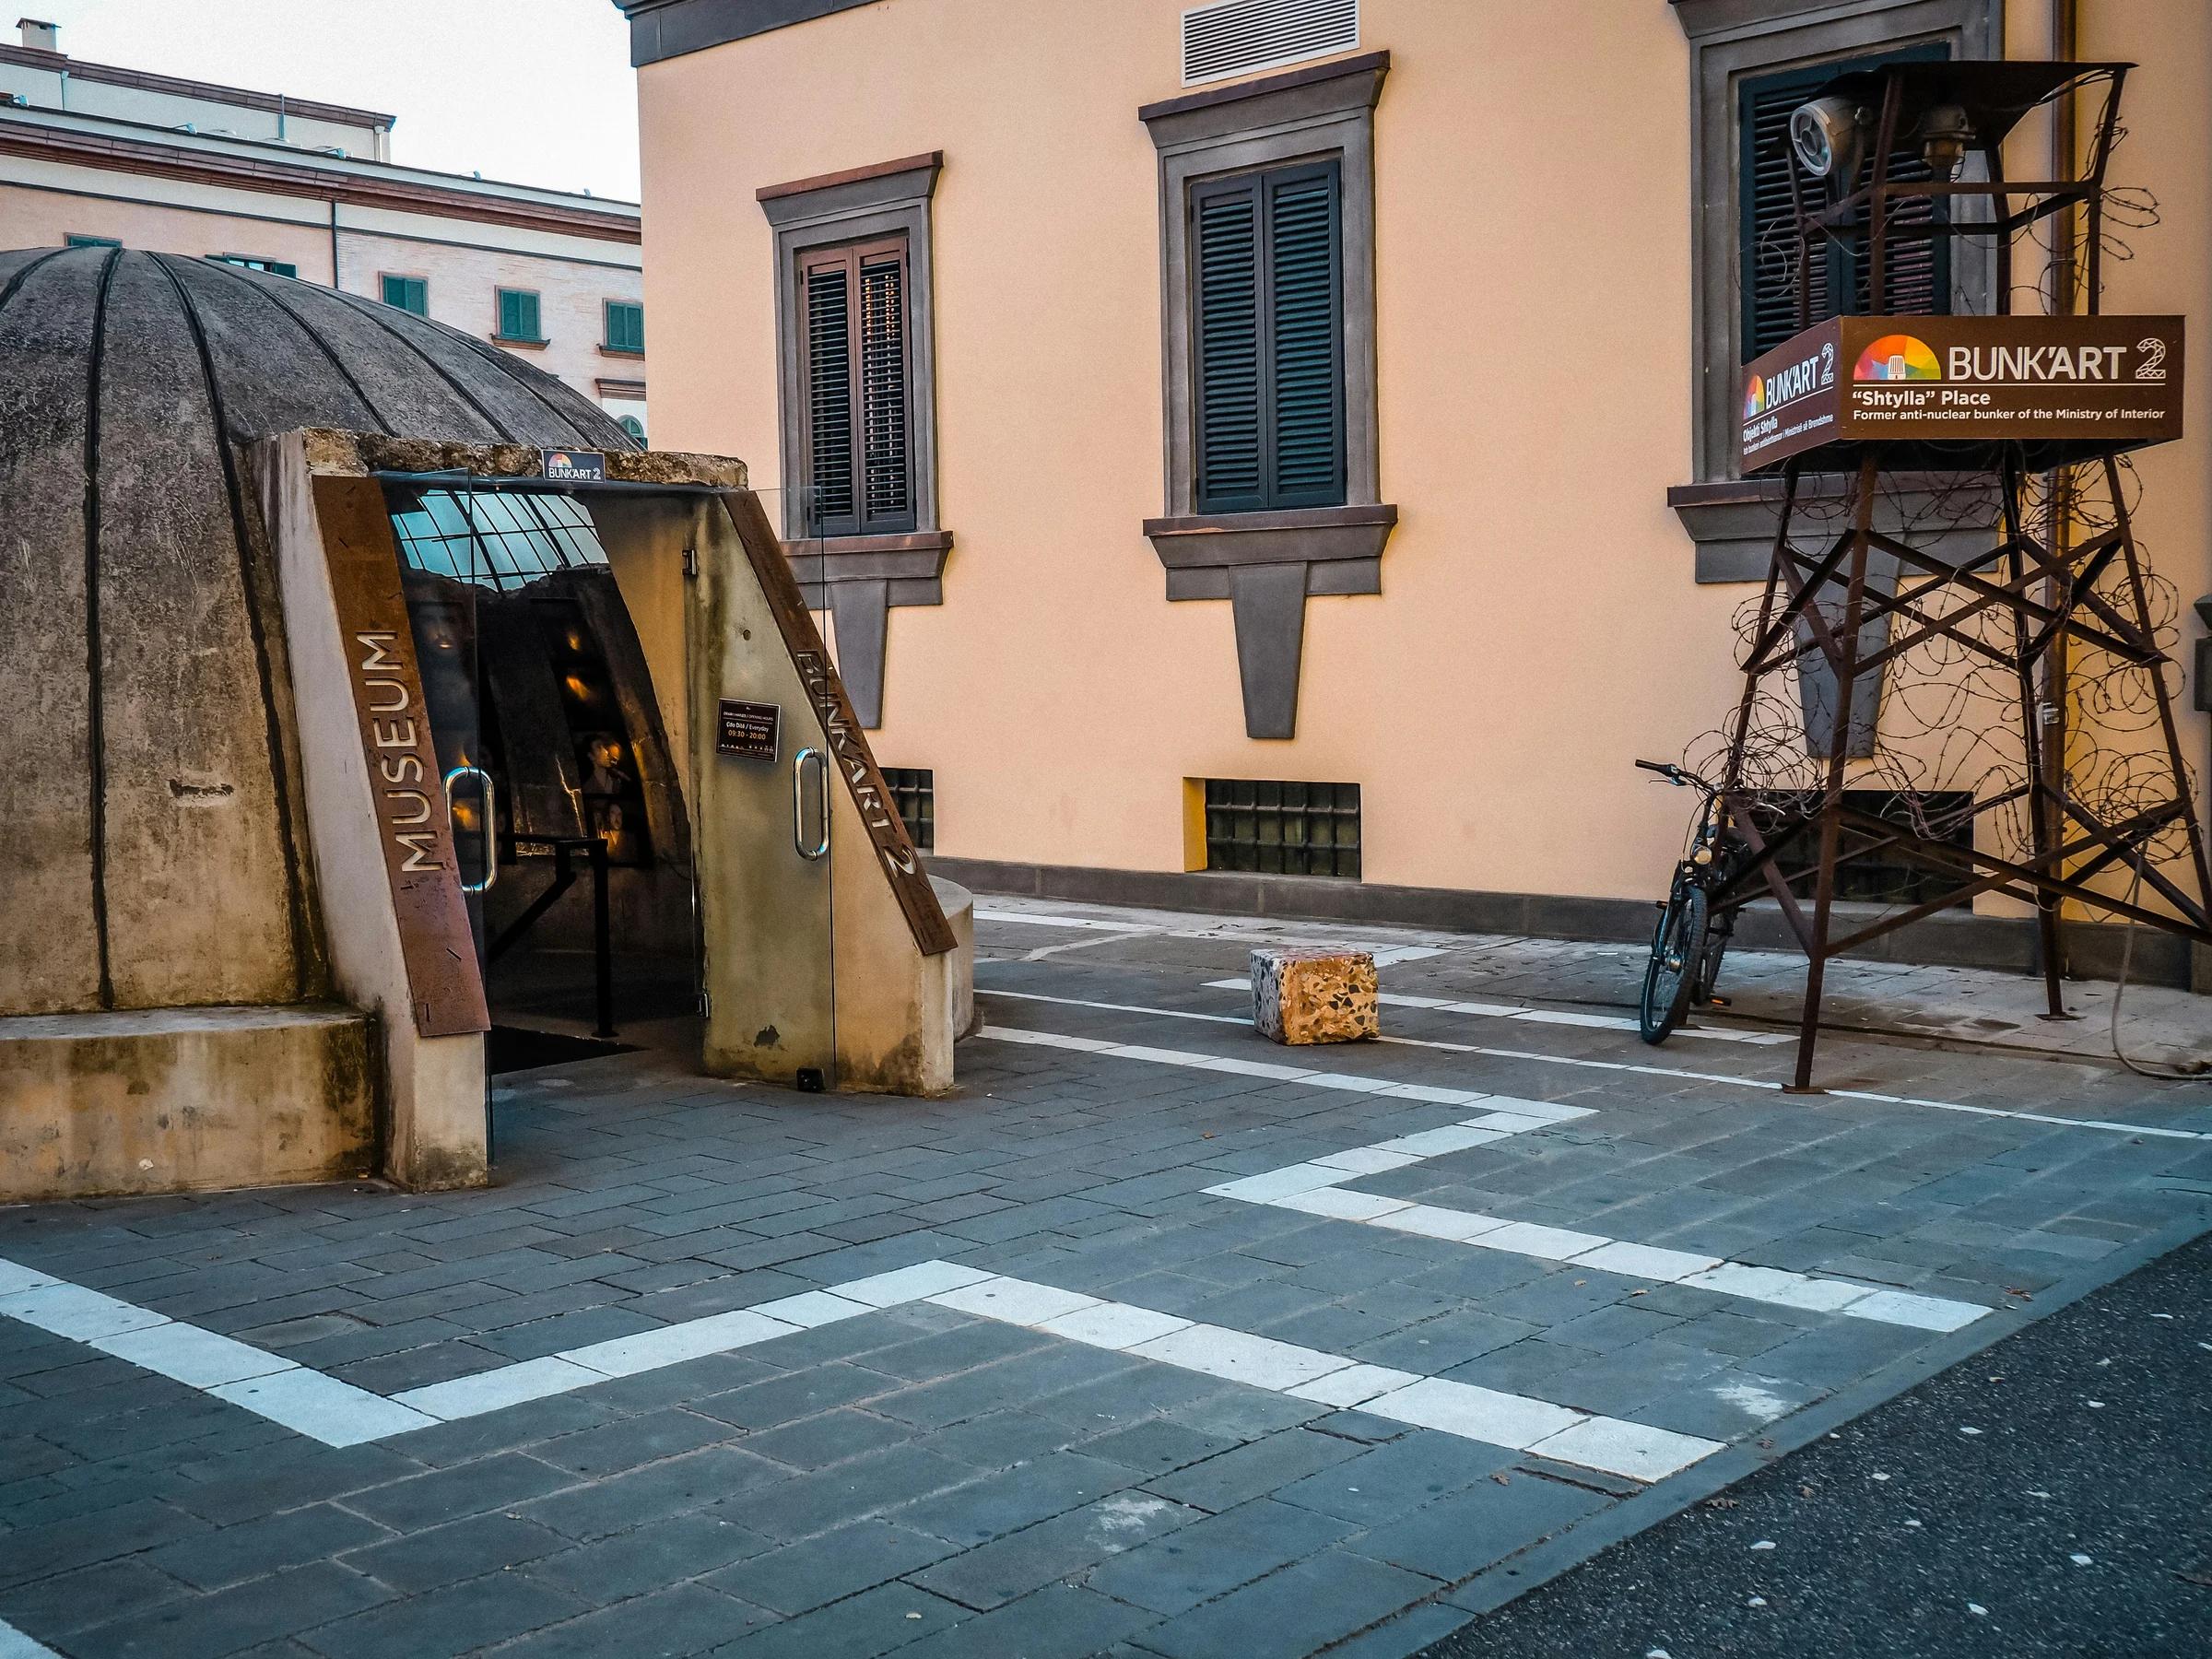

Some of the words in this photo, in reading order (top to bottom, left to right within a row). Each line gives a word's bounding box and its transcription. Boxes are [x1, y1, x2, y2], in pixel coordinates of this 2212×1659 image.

[1948, 346, 2127, 381] BUNK'ART
[2136, 337, 2167, 380] 2
[1766, 356, 1819, 409] BUNK'ART
[1821, 342, 1834, 385] 2
[1941, 390, 1991, 406] Place
[1853, 409, 1896, 420] Former
[1900, 408, 1971, 420] anti-nuclear
[1974, 408, 2016, 420] bunker
[2018, 408, 2031, 419] of
[2033, 408, 2053, 419] the
[2056, 408, 2102, 422] Ministry
[2105, 408, 2119, 419] of
[2121, 408, 2166, 419] Interior
[1743, 422, 1760, 442] Objekti
[1760, 416, 1778, 434] Shtylla
[548, 467, 591, 479] BUNK'ART
[593, 467, 601, 480] 2
[728, 729, 745, 737] 09:30
[749, 732, 766, 740] 20:00
[748, 724, 769, 733] Everyday
[356, 630, 444, 873] MUSEUM
[882, 842, 918, 878] 2
